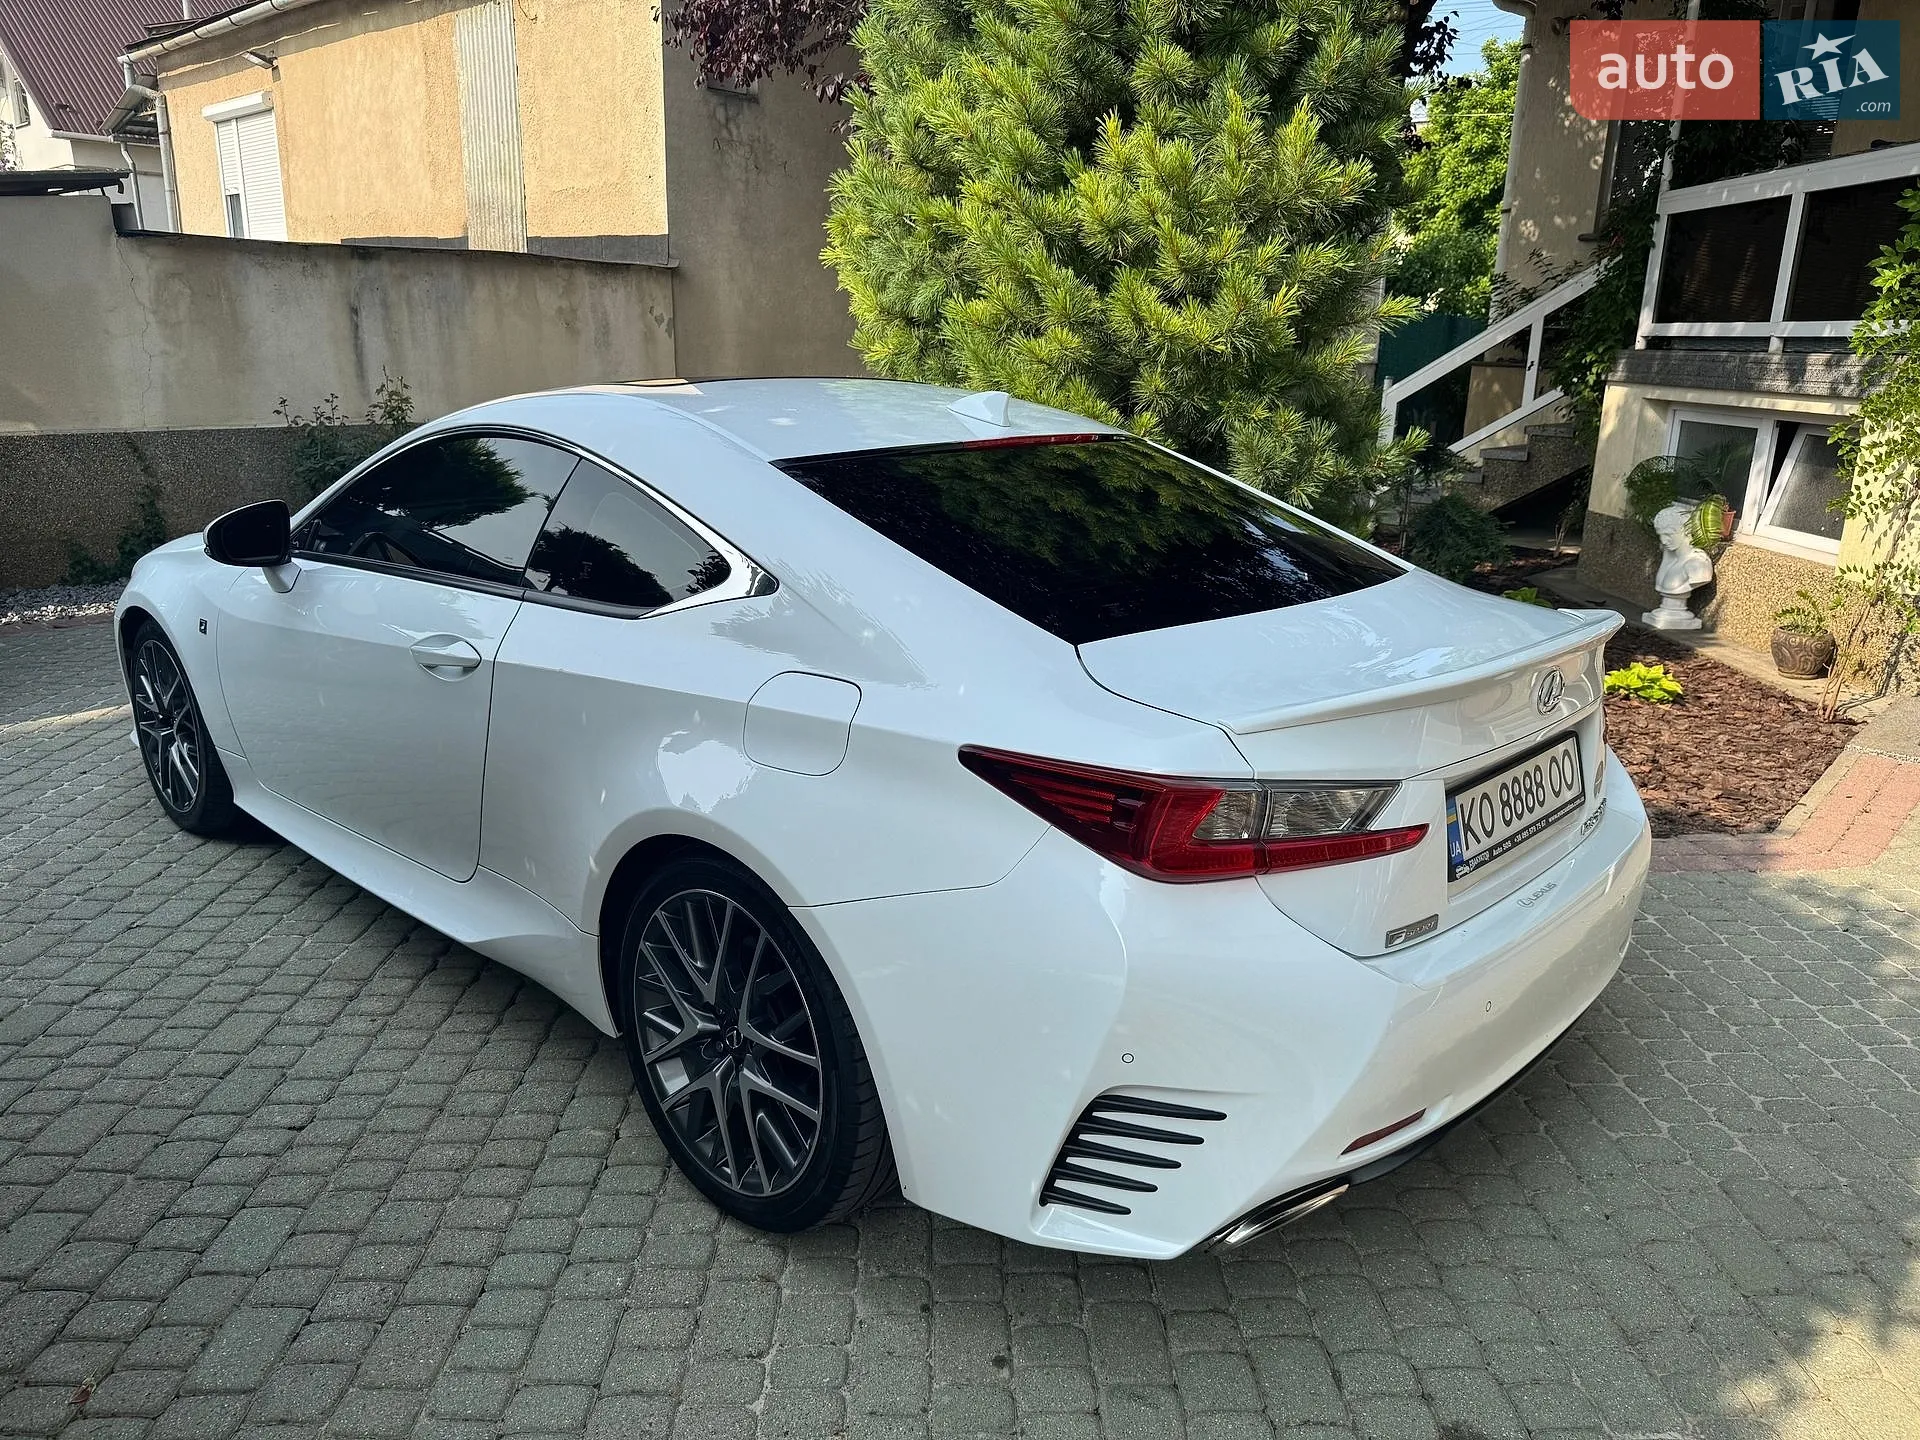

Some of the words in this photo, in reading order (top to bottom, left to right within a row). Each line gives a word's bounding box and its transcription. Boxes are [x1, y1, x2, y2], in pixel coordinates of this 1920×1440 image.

[1459, 792, 1495, 851] KO
[1499, 764, 1546, 827] 8888
[1549, 748, 1574, 799] OO
[1450, 841, 1461, 857] UA
[1527, 881, 1557, 901] LEXUS
